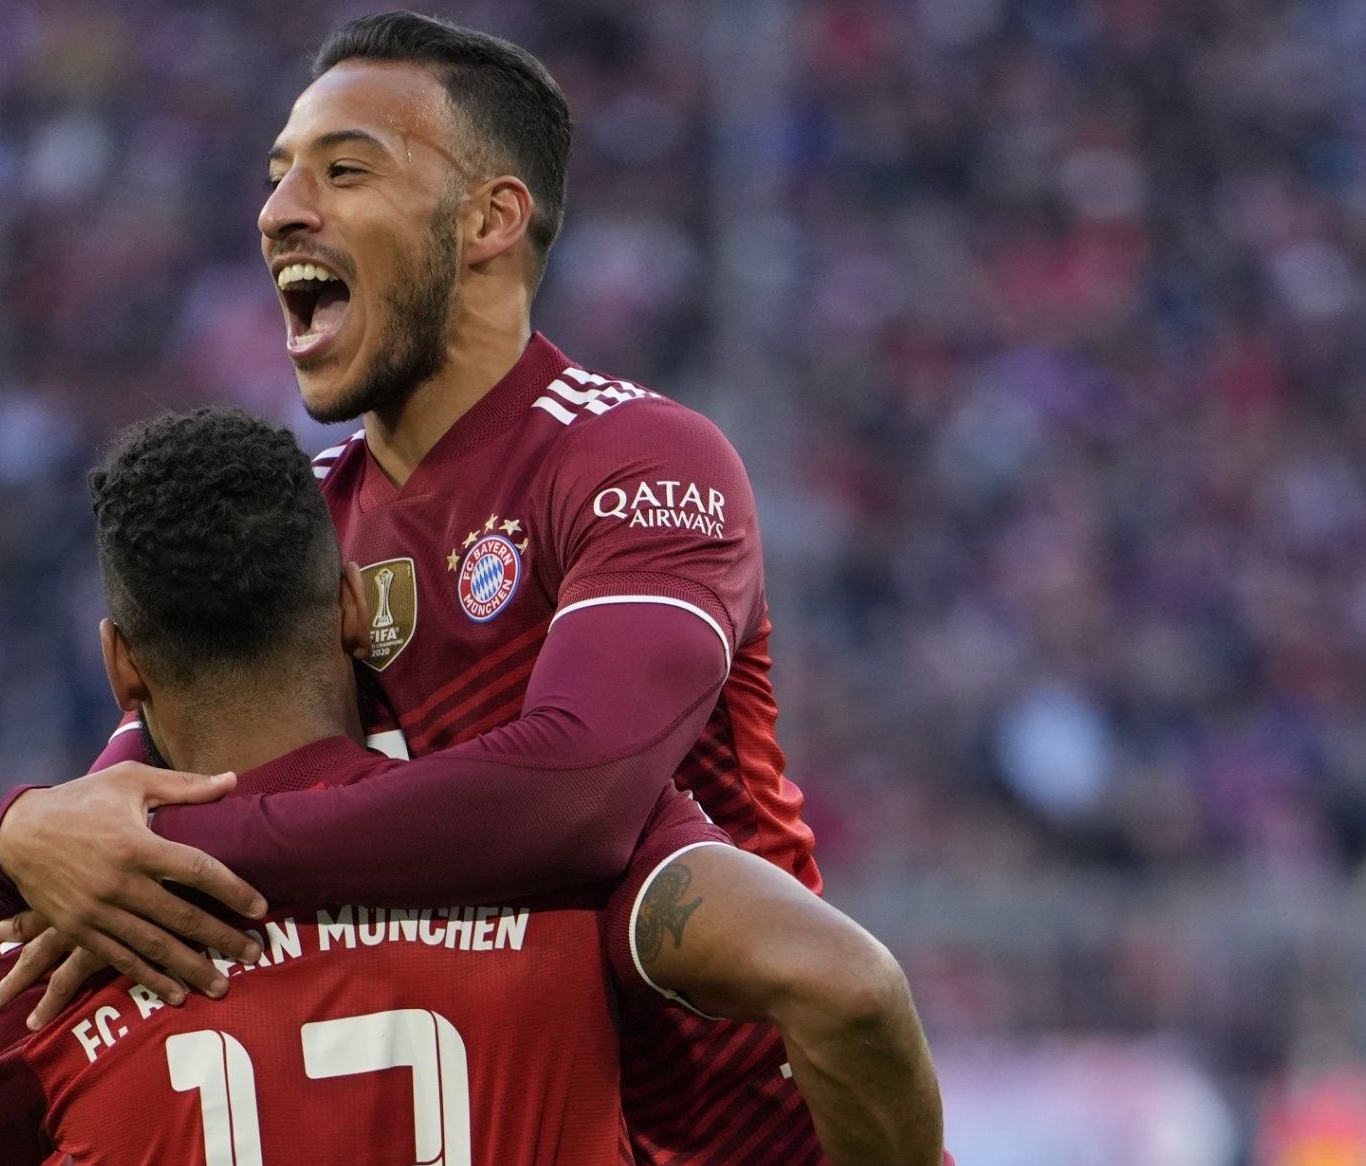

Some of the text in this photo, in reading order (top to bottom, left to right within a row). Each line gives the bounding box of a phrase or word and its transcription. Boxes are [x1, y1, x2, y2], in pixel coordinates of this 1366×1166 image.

[593, 480, 725, 523] QATAR
[629, 508, 723, 539] AIRWAYS
[463, 541, 513, 580] FC BAYERN
